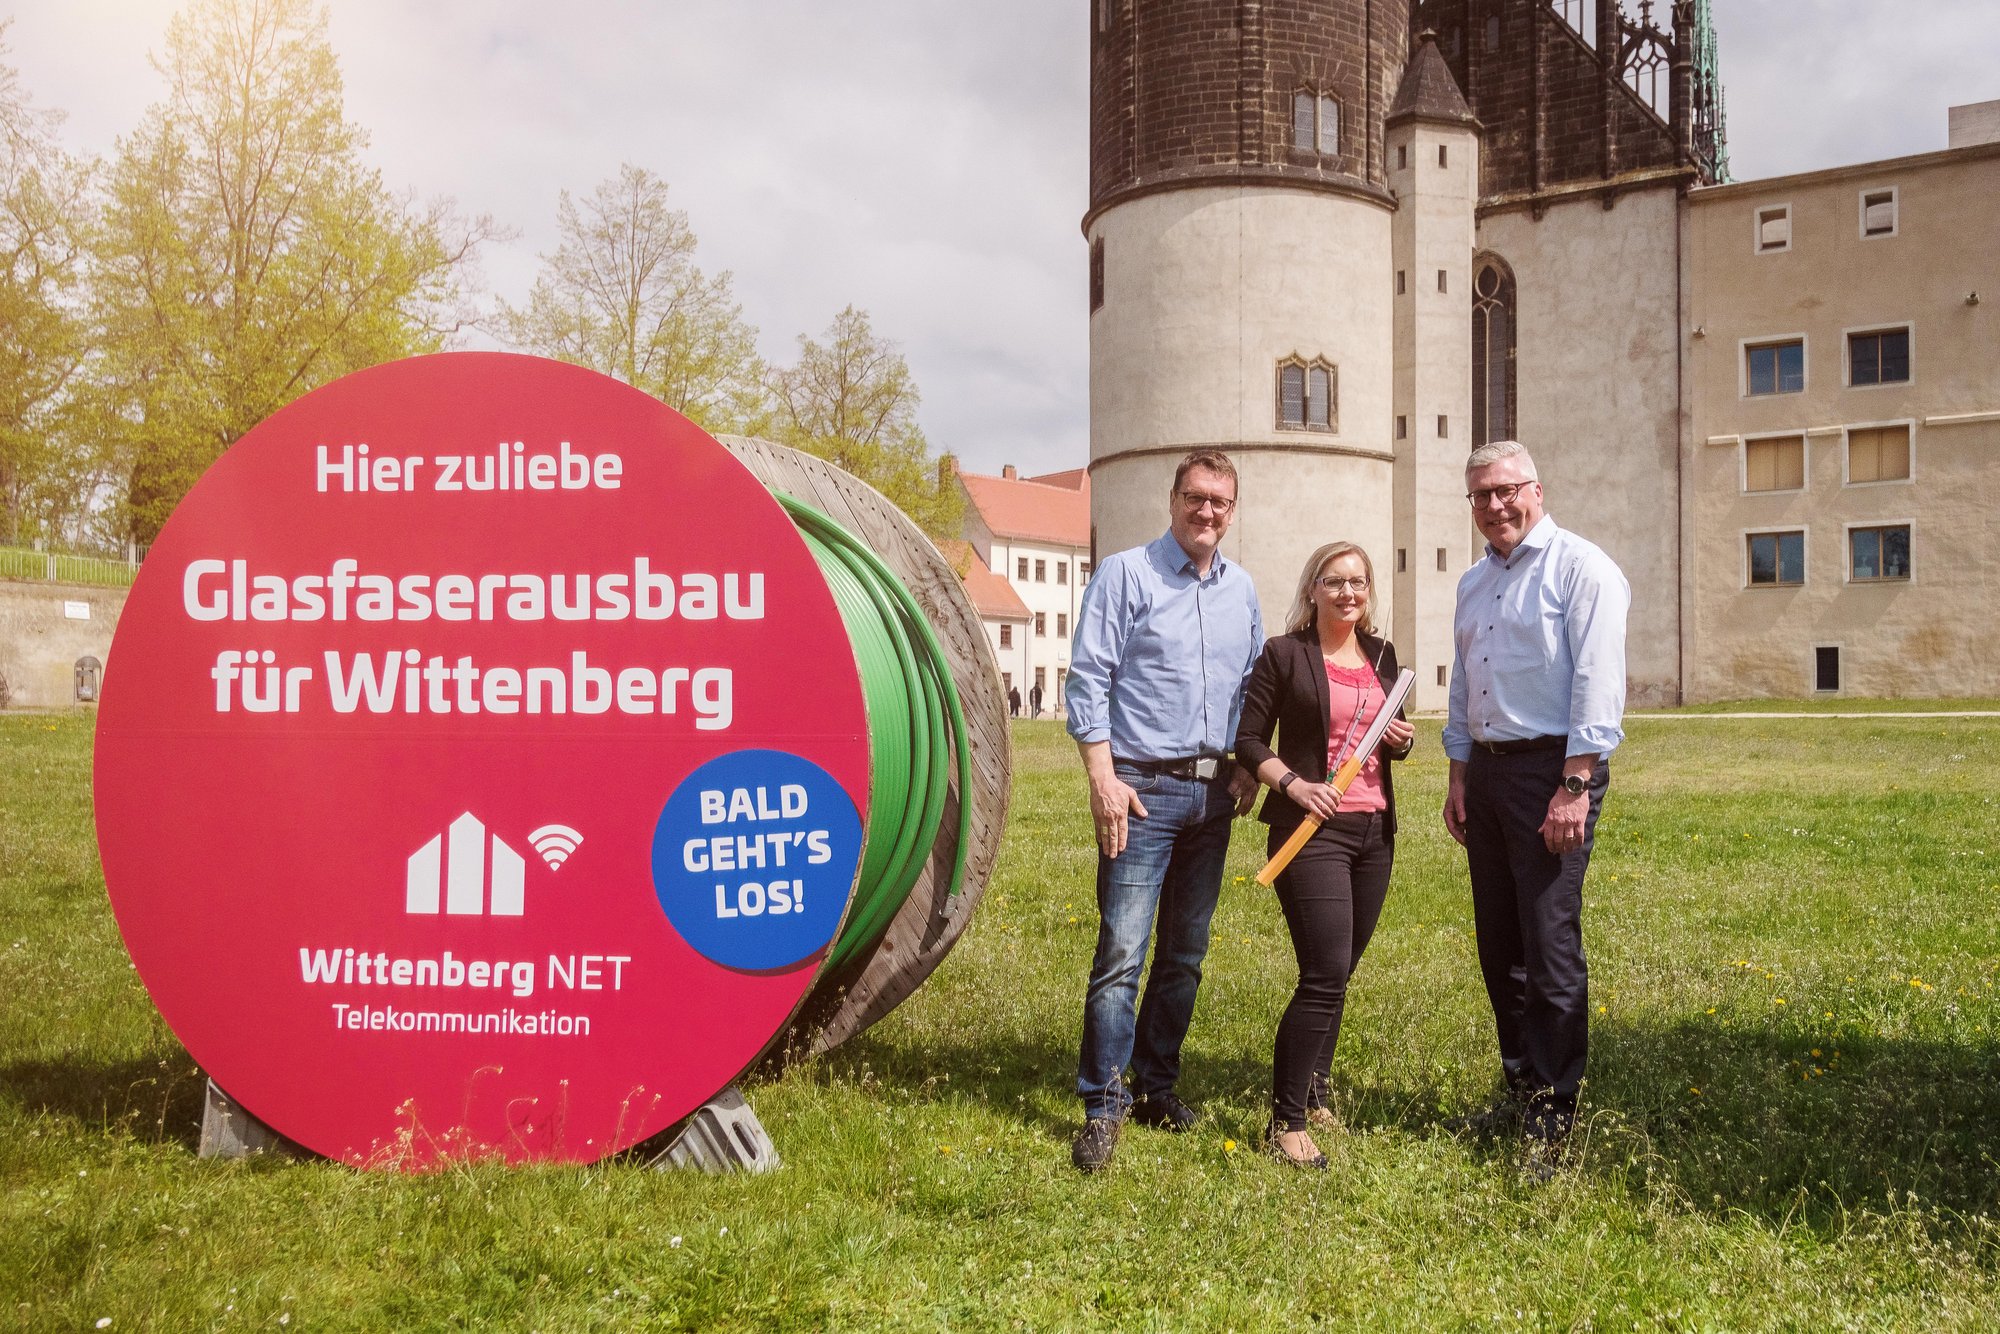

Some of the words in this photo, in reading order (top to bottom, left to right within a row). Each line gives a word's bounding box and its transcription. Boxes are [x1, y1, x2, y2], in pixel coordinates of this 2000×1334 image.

[316, 443, 425, 493] Hier
[433, 440, 623, 492] zuliebe
[183, 556, 765, 622] Glasfaserausbau
[210, 649, 313, 713] für
[323, 648, 734, 731] Wittenberg
[699, 783, 809, 825] BALD
[683, 829, 832, 873] GEHT’S
[715, 879, 805, 919] LOS!
[299, 947, 535, 997] Wittenberg
[547, 954, 632, 991] NET
[331, 1003, 590, 1036] Telekommunikation
